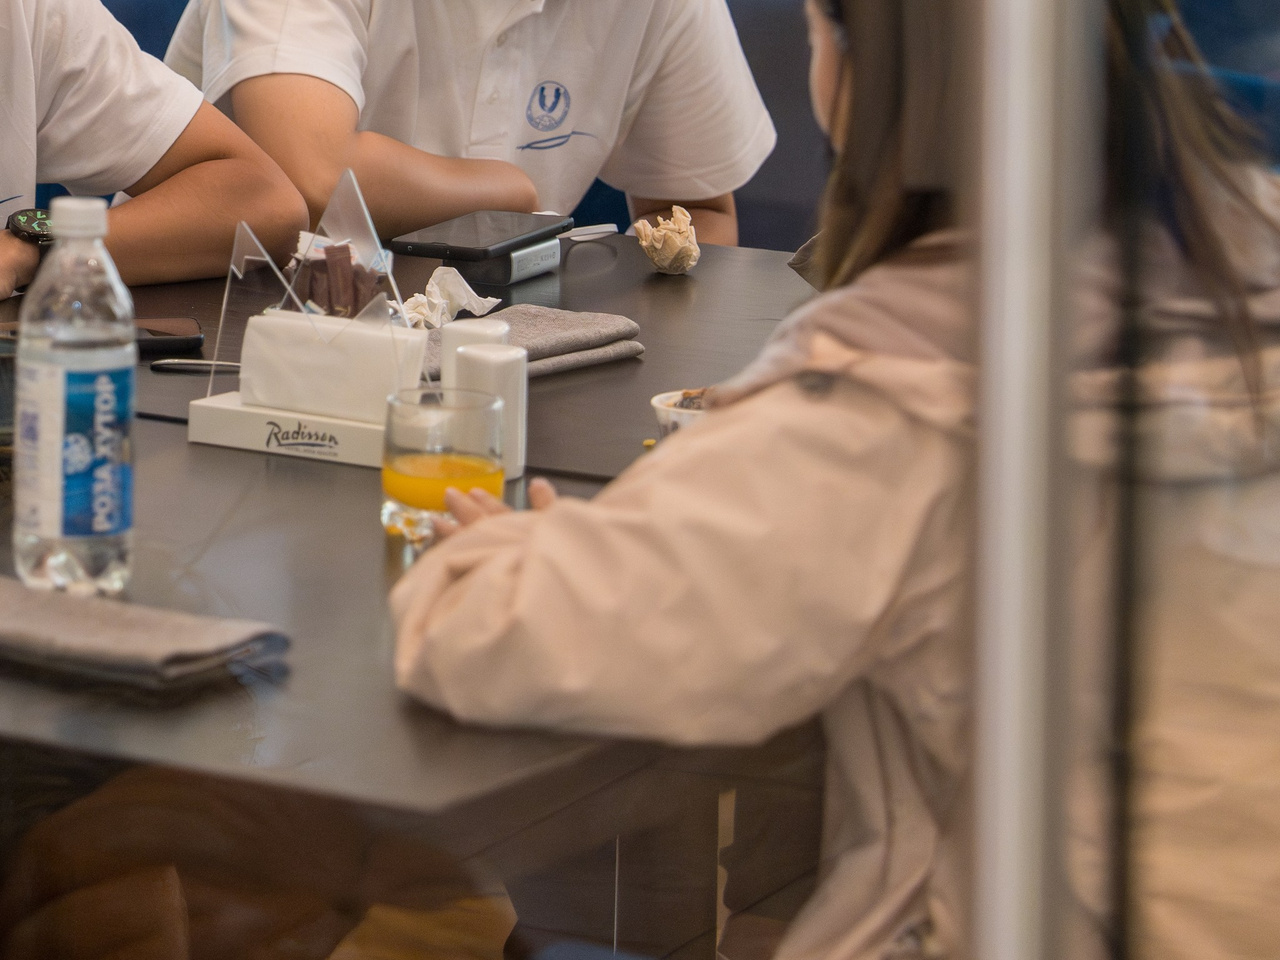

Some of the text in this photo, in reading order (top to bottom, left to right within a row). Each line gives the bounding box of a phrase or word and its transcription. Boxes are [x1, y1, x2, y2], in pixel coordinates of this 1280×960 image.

[91, 375, 117, 532] РОЗА ХУТОР
[266, 420, 339, 448] Radisson
